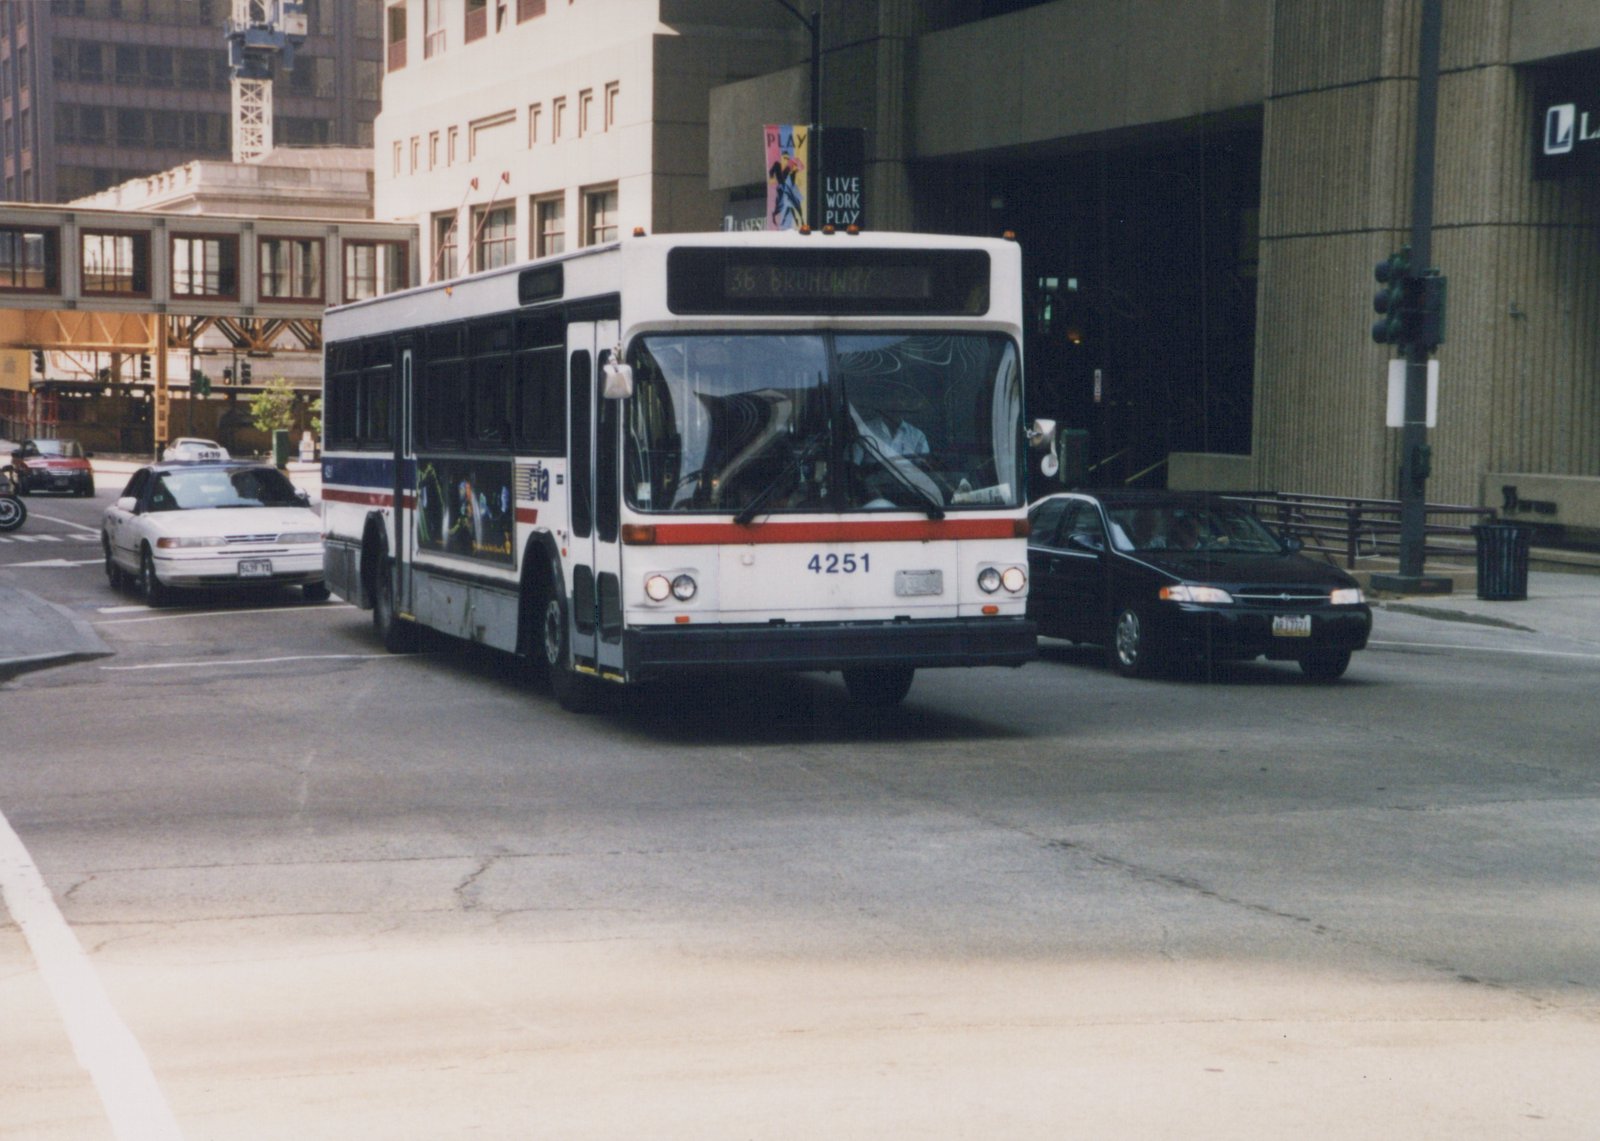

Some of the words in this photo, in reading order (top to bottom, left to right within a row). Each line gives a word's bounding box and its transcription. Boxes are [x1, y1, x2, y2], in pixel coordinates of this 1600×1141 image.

[766, 133, 807, 149] PLAY
[826, 177, 859, 192] LIVE
[826, 193, 860, 210] WORK
[826, 210, 860, 225] PLAY
[731, 268, 756, 292] 36
[807, 553, 870, 573] 4251
